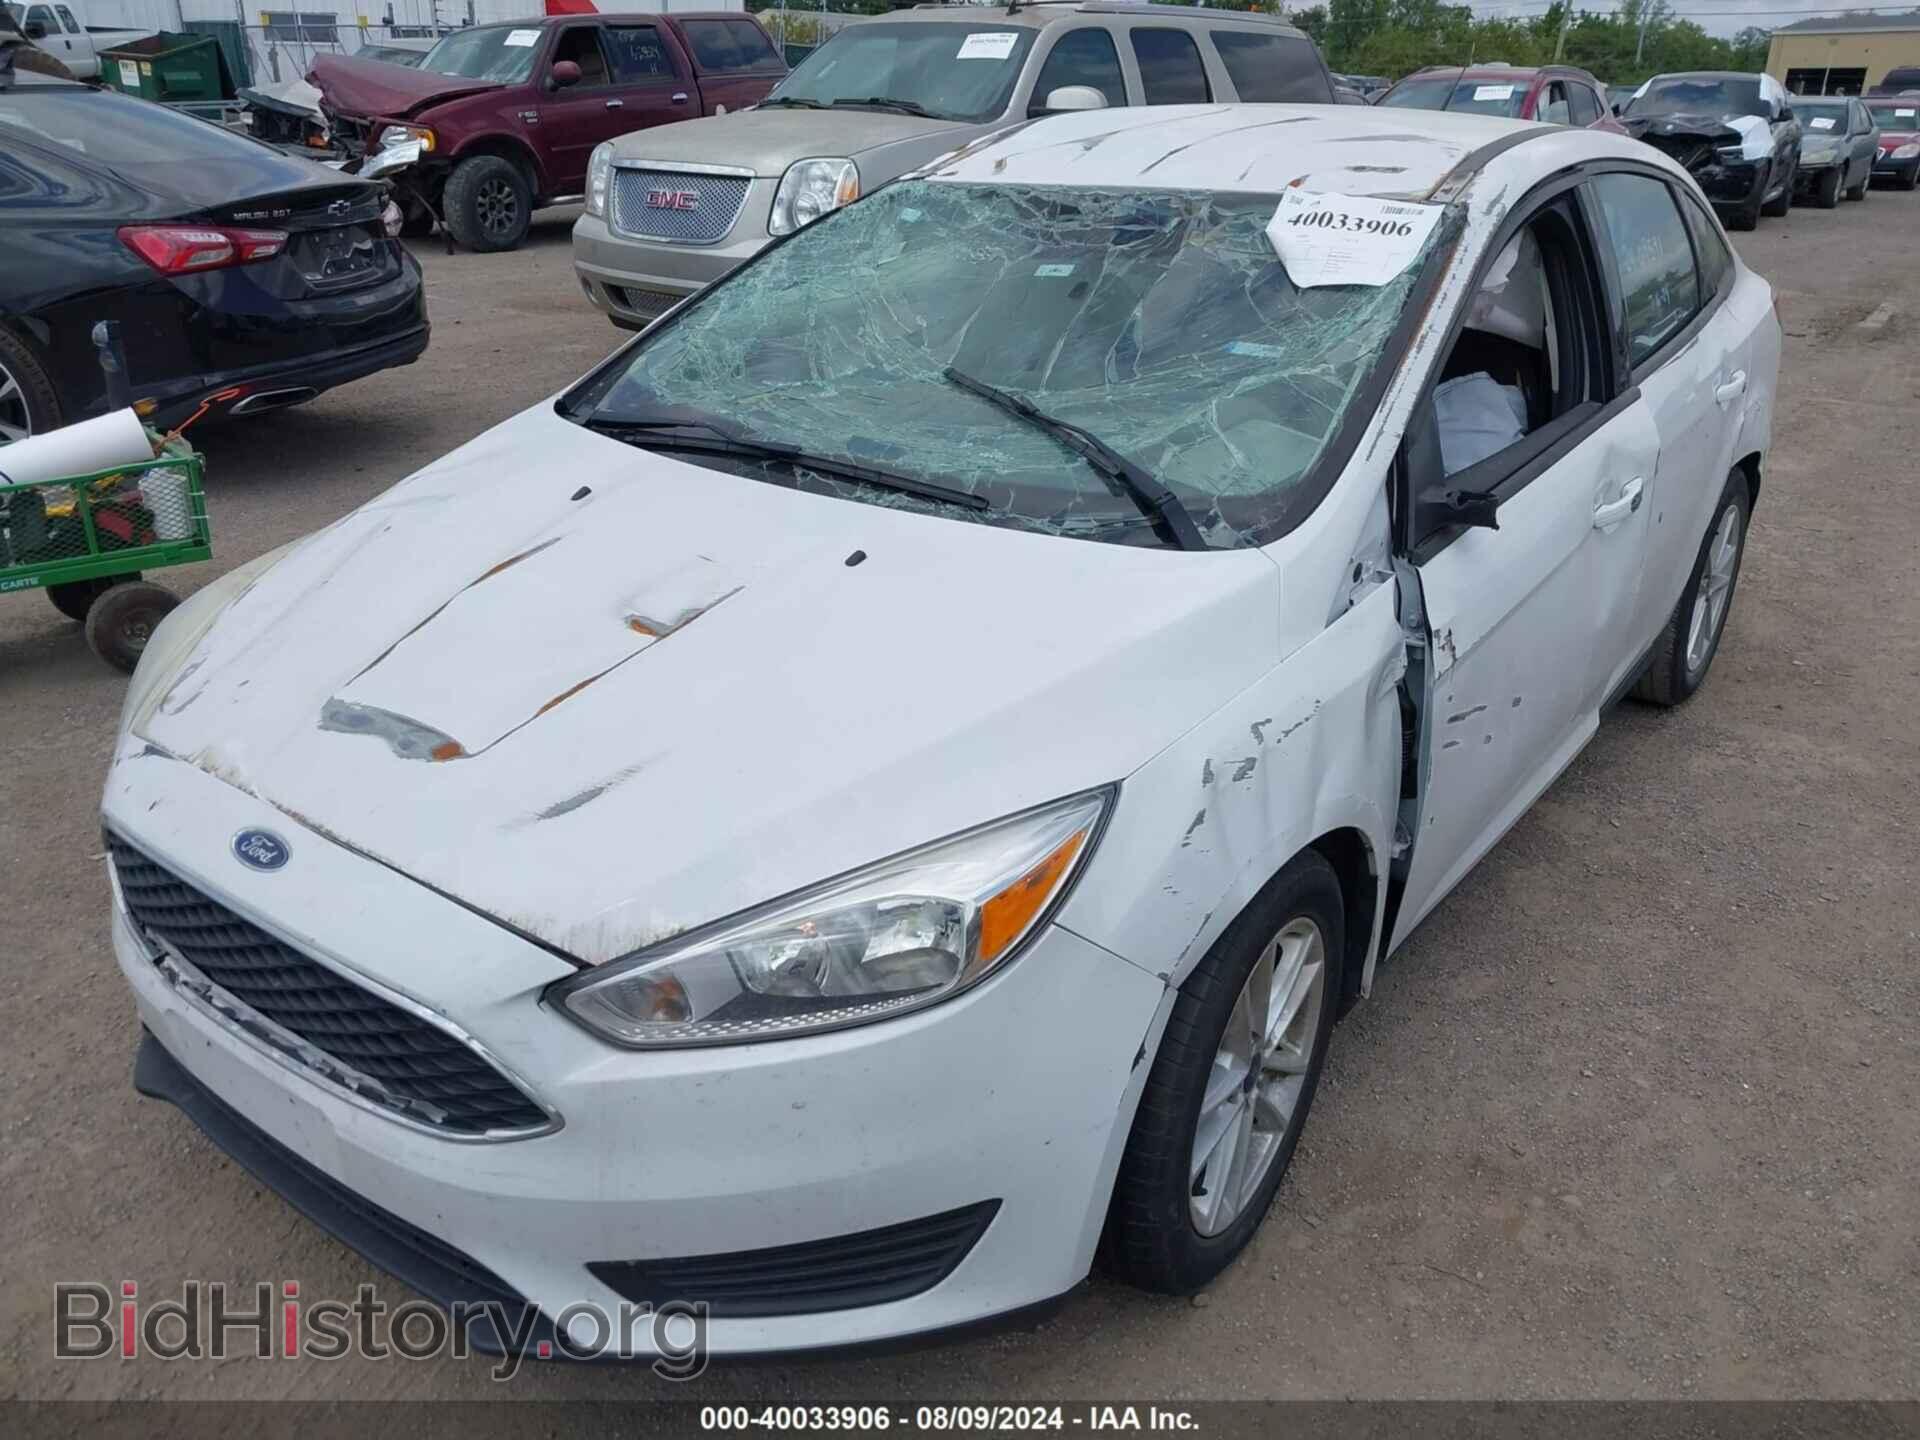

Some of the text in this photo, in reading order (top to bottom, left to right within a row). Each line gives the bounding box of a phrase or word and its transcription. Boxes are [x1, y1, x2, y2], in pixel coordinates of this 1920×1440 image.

[645, 190, 697, 209] GMC
[1288, 210, 1416, 237] 40033906
[240, 835, 278, 864] Ford
